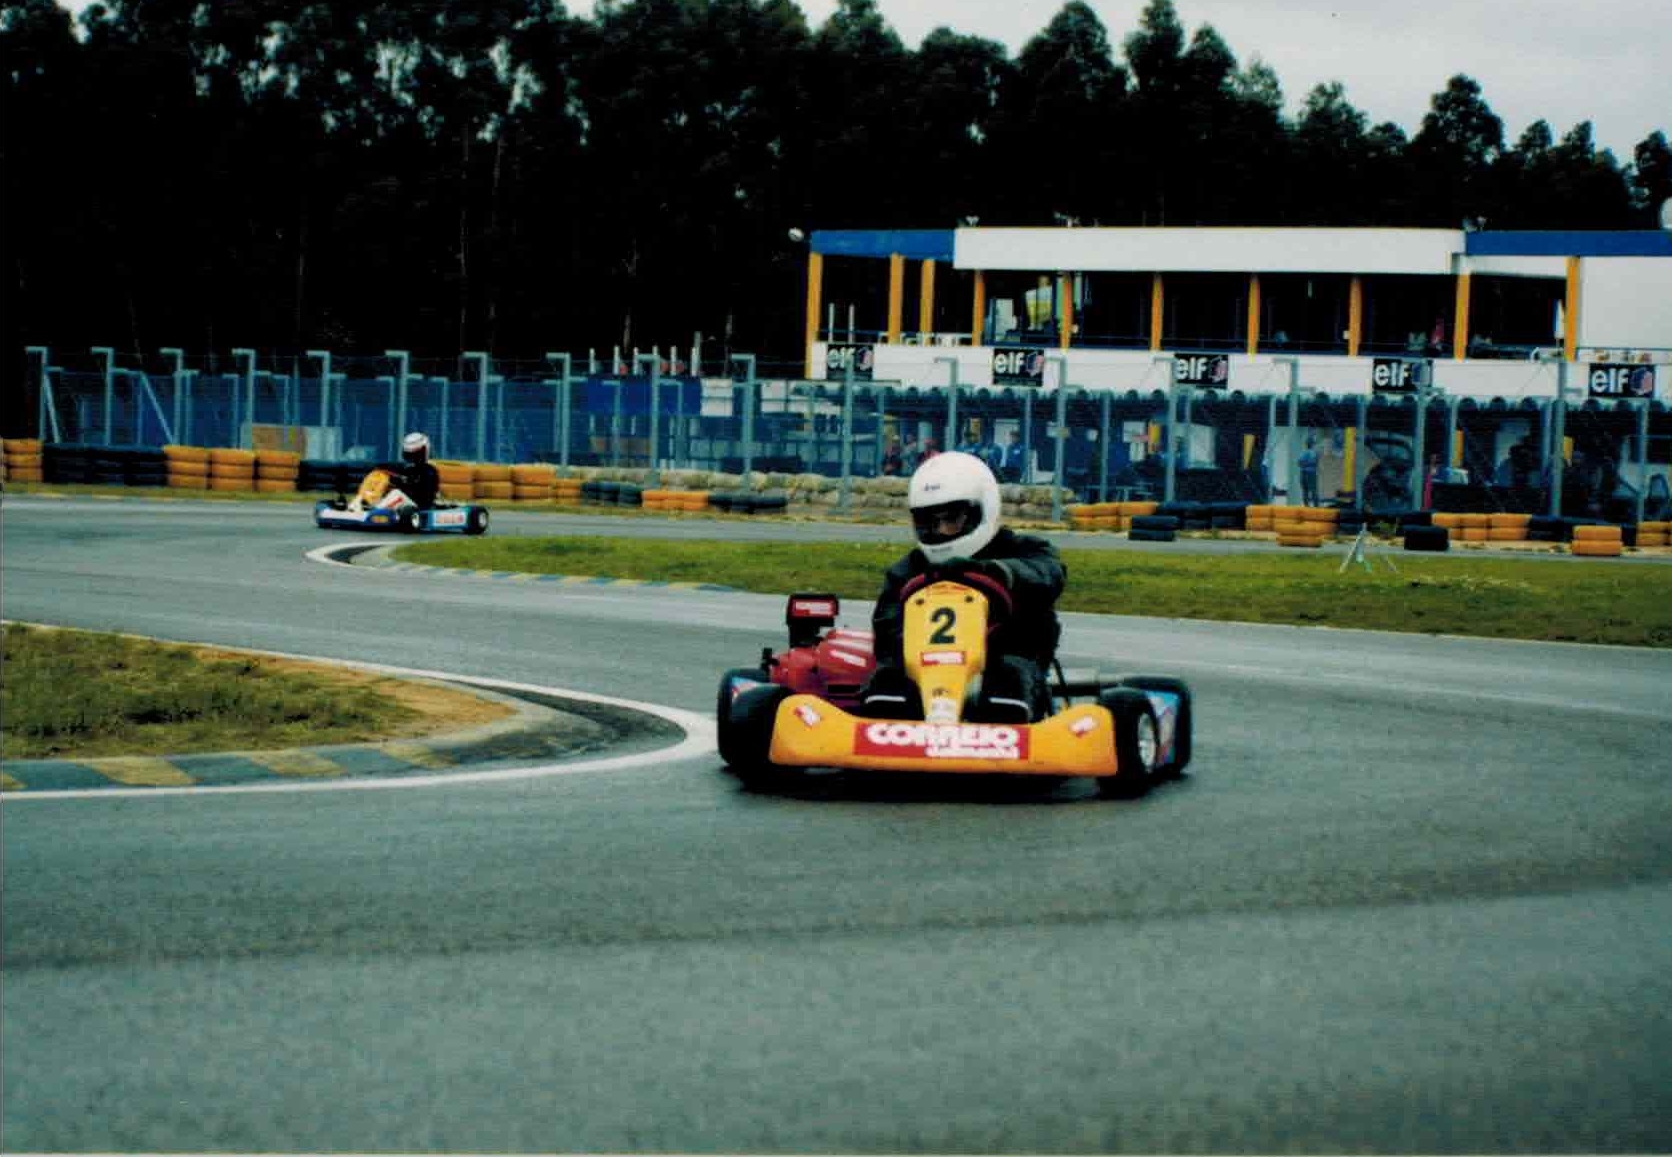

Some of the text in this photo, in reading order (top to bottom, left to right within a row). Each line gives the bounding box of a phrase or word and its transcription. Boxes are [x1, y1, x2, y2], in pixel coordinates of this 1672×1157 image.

[994, 352, 1025, 374] elf
[1176, 357, 1207, 380] elf
[1375, 363, 1410, 387] elf
[1592, 368, 1629, 393] elf
[930, 607, 956, 644] 2
